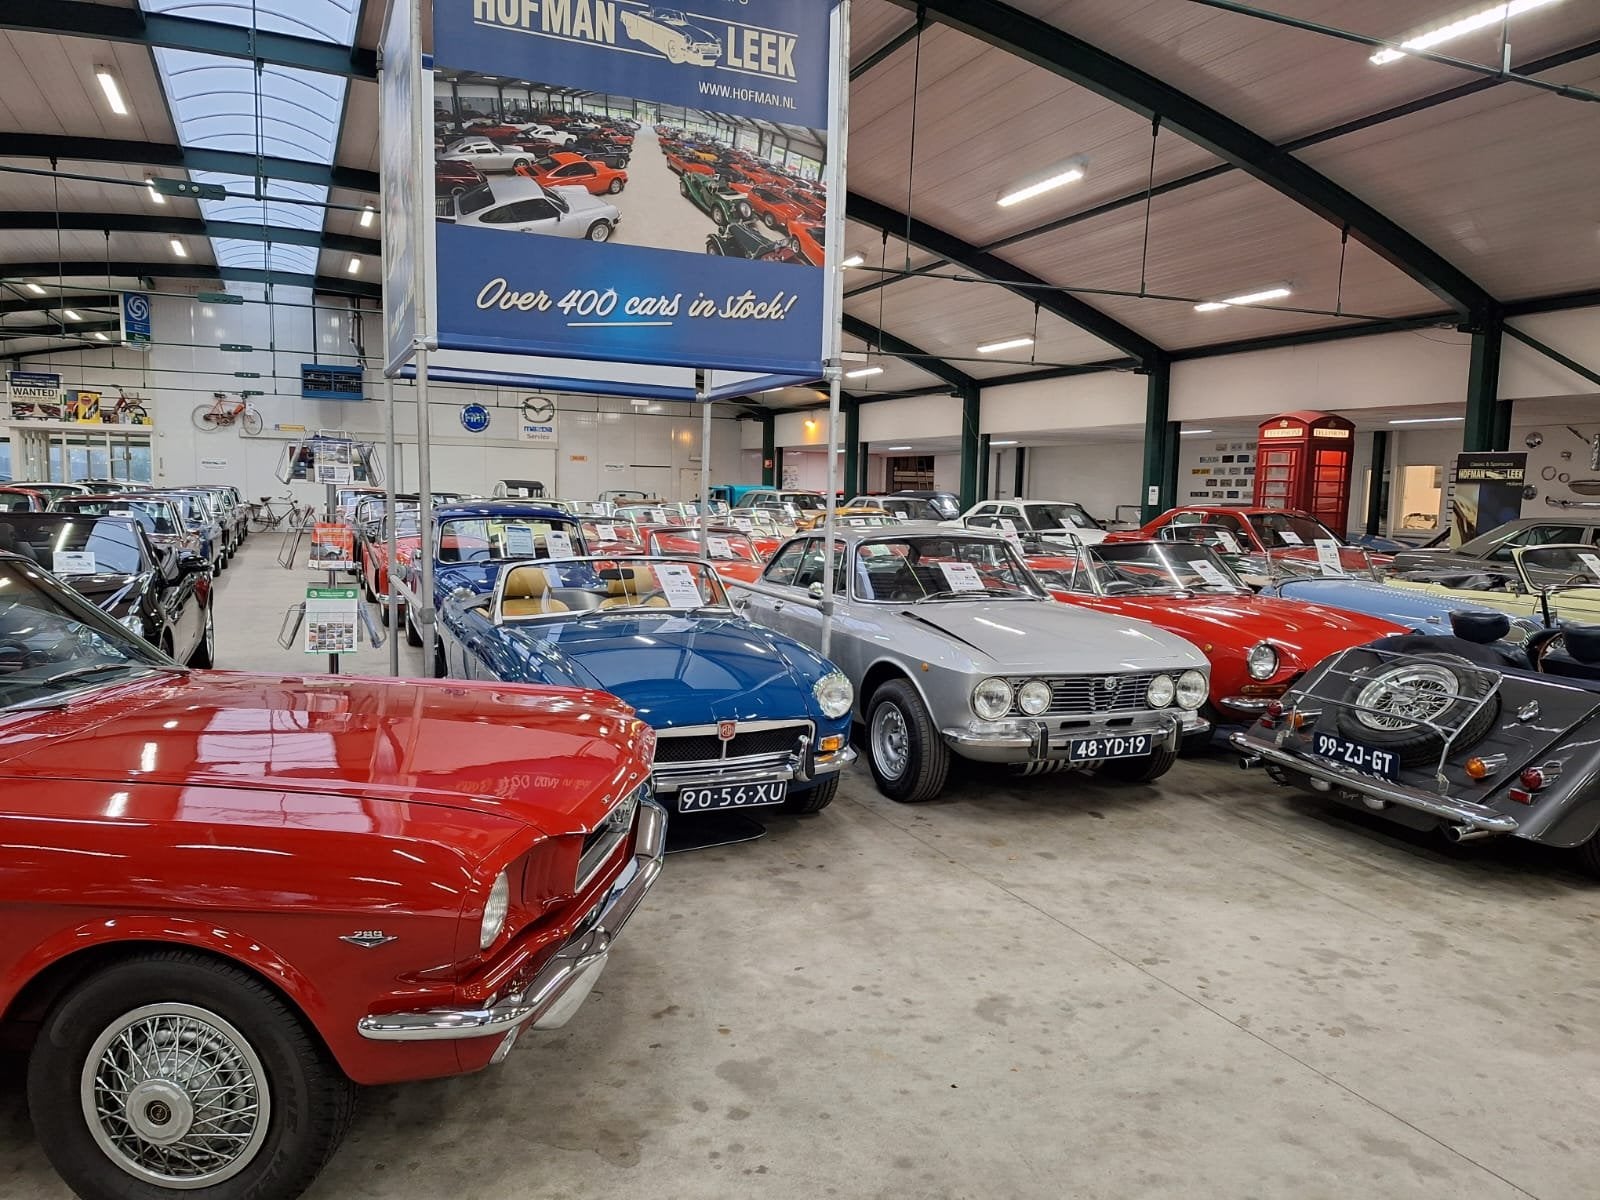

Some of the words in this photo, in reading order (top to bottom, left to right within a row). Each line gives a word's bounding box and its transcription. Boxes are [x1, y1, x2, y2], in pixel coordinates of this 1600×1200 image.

[727, 25, 796, 77] LEEK
[698, 81, 797, 110] WWW.HOFMAN.NL
[476, 277, 552, 311] Over
[557, 288, 618, 317] 400
[624, 293, 682, 317] cars
[688, 292, 717, 318] in
[718, 292, 798, 320] stock!
[12, 387, 58, 397] WANTED!
[1458, 469, 1486, 480] HOFMAN
[1507, 469, 1525, 480] LEEK
[1076, 736, 1146, 759] 48-YD-19
[1319, 735, 1393, 774] 99-ZJ-GT
